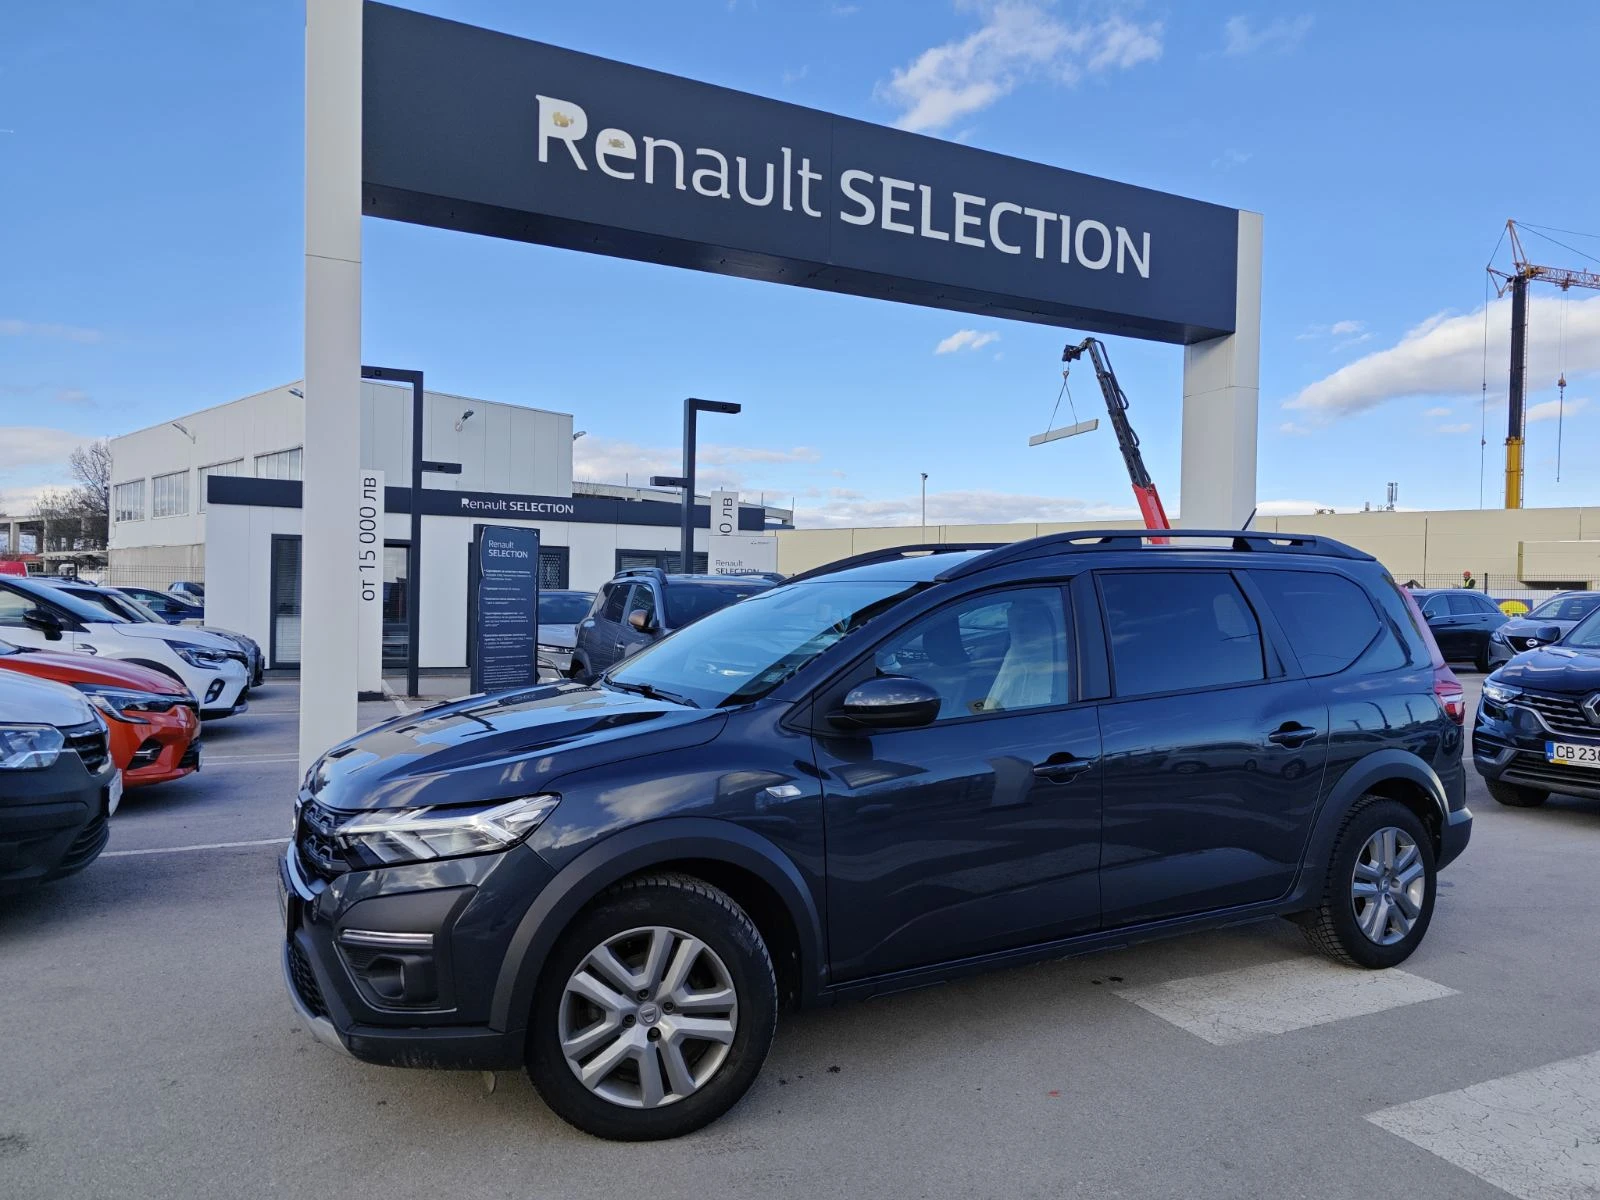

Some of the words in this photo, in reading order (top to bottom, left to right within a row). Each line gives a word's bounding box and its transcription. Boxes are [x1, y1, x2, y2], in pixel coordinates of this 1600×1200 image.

[535, 94, 823, 218] Renault
[839, 169, 1151, 279] SELECTION
[363, 477, 376, 501] ЛВ
[461, 498, 507, 511] Renault
[509, 501, 574, 514] SELECTION
[722, 498, 732, 519] ЛВ
[359, 506, 376, 544] 000
[488, 539, 514, 549] Renault
[488, 549, 528, 559] SELECTION
[359, 550, 375, 572] 15
[362, 579, 375, 601] ОТ
[1556, 745, 1575, 759] CB
[1579, 747, 1600, 761] 23
